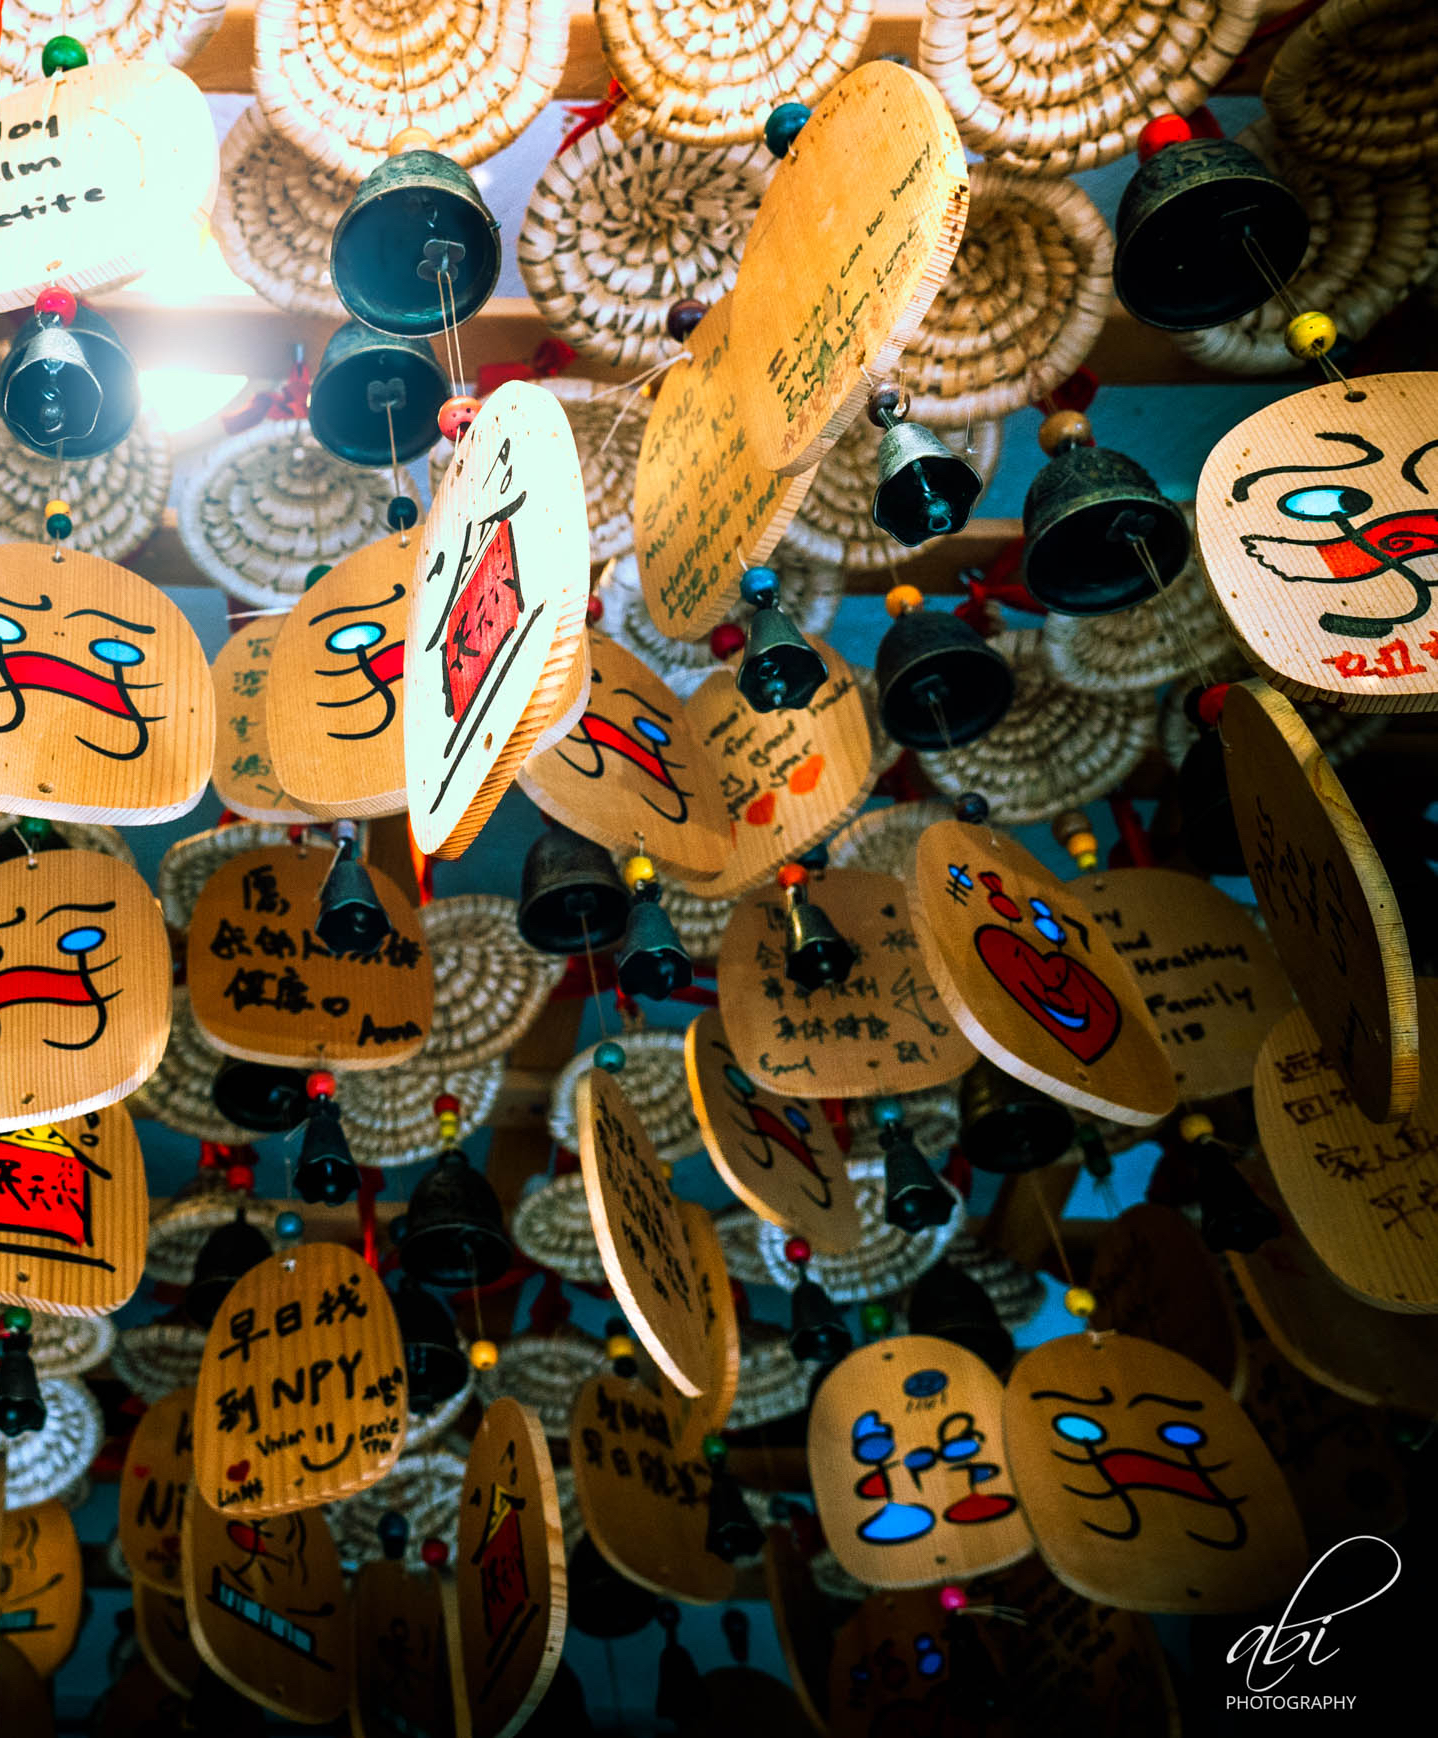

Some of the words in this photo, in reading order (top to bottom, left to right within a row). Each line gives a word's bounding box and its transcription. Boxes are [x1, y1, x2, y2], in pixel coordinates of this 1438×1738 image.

[866, 209, 885, 238] be
[890, 141, 931, 201] happy
[1134, 942, 1249, 975] Healthy
[1143, 980, 1255, 1018] Family
[270, 1350, 363, 1410] NPY
